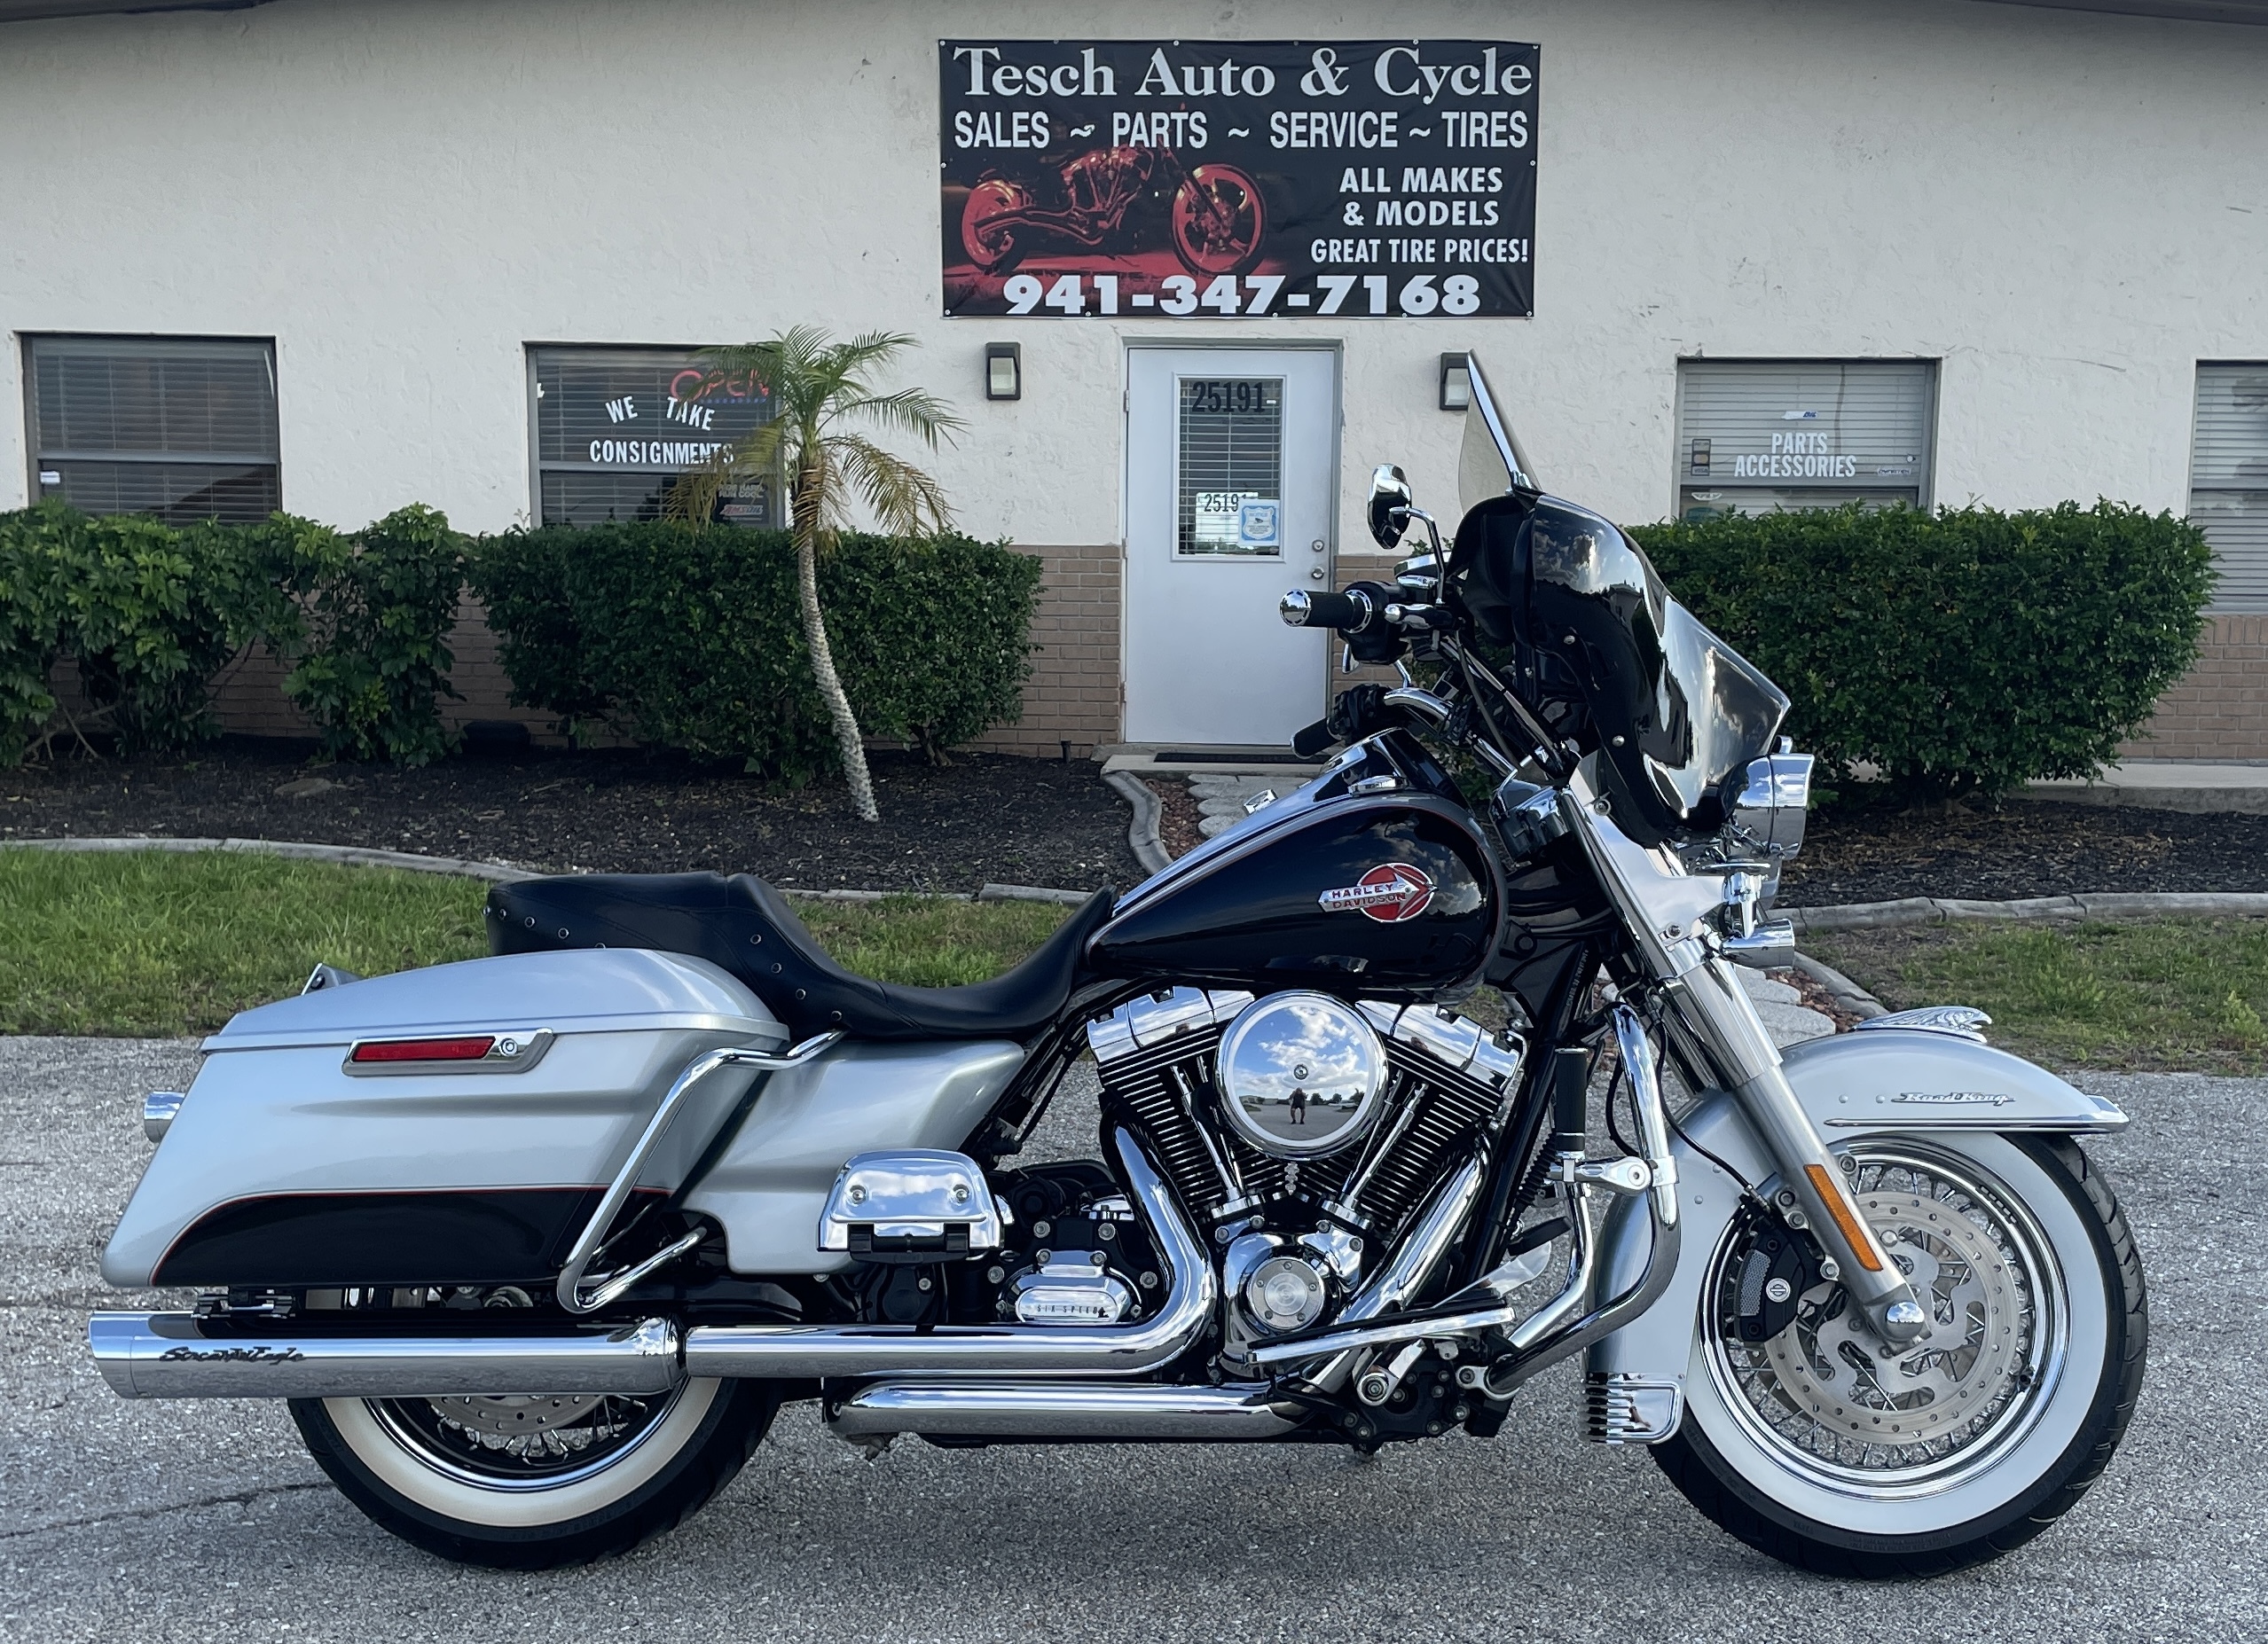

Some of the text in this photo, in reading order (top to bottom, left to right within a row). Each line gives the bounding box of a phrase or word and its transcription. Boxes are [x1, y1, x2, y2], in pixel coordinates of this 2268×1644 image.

[953, 47, 1533, 105] Tesch Auto & Cycle
[954, 111, 1050, 148] SALES
[1112, 111, 1208, 148] PARTS
[1269, 111, 1398, 147] SERVICE
[1441, 111, 1528, 148] TIRES
[1339, 167, 1503, 192] ALL MAKES
[1343, 200, 1500, 226] & MODELS
[1310, 239, 1528, 262] GREAT TIRE PRICES!
[1003, 275, 1479, 315] 941-347-7168
[1191, 381, 1266, 412] 25191
[605, 395, 715, 431] WE TAKE
[589, 440, 734, 465] CONSIGNMENTS
[1771, 432, 1828, 454] PARTS
[1734, 455, 1856, 477] ACCESSORIES
[1204, 494, 1247, 512] 2519
[1332, 892, 1407, 909] DAVIDSON
[1063, 1305, 1098, 1314] SPEED
